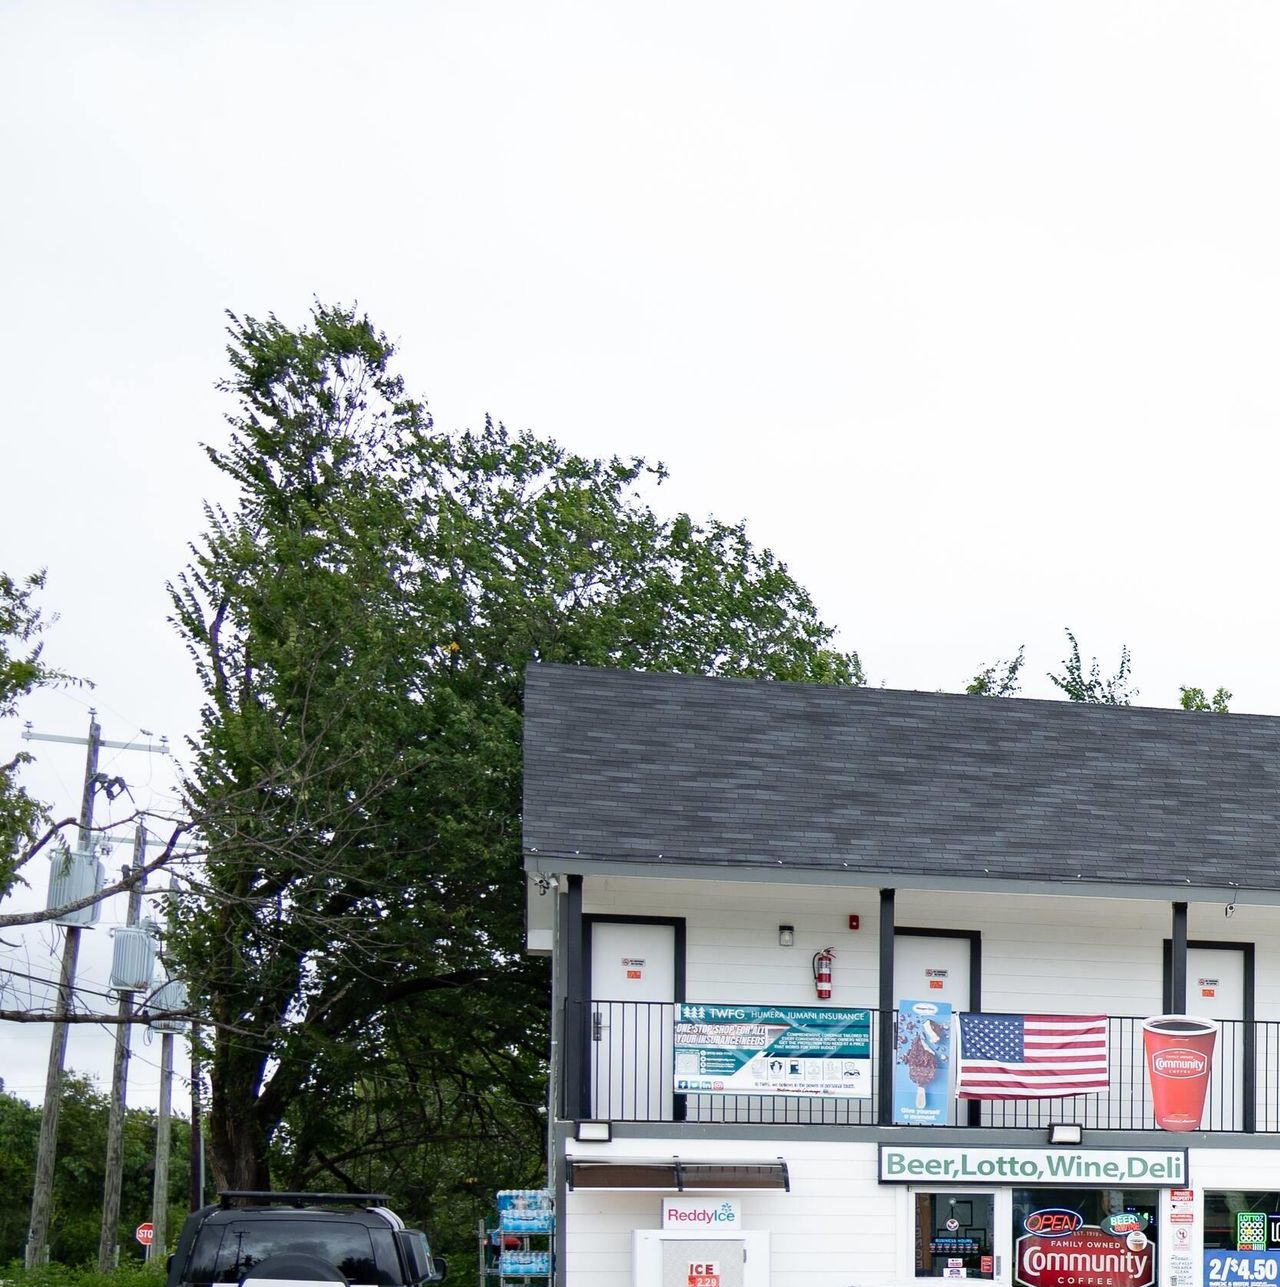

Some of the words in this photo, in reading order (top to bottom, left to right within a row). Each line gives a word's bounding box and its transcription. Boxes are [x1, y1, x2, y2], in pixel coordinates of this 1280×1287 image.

[709, 1008, 745, 1019] TWFG
[751, 1010, 784, 1019] HUMERA
[786, 1011, 817, 1020] JUMANI
[819, 1012, 865, 1021] INSURANCE
[1155, 1057, 1204, 1071] Community
[1027, 1215, 1078, 1231] OPEN
[1110, 1216, 1136, 1226] BEER
[139, 1229, 153, 1238] STO
[1051, 1240, 1083, 1248] FAMILY
[1087, 1241, 1121, 1249] OWNED
[1023, 1246, 1147, 1279] Community
[690, 1263, 714, 1275] ICE
[1057, 1277, 1113, 1285] COFFEE
